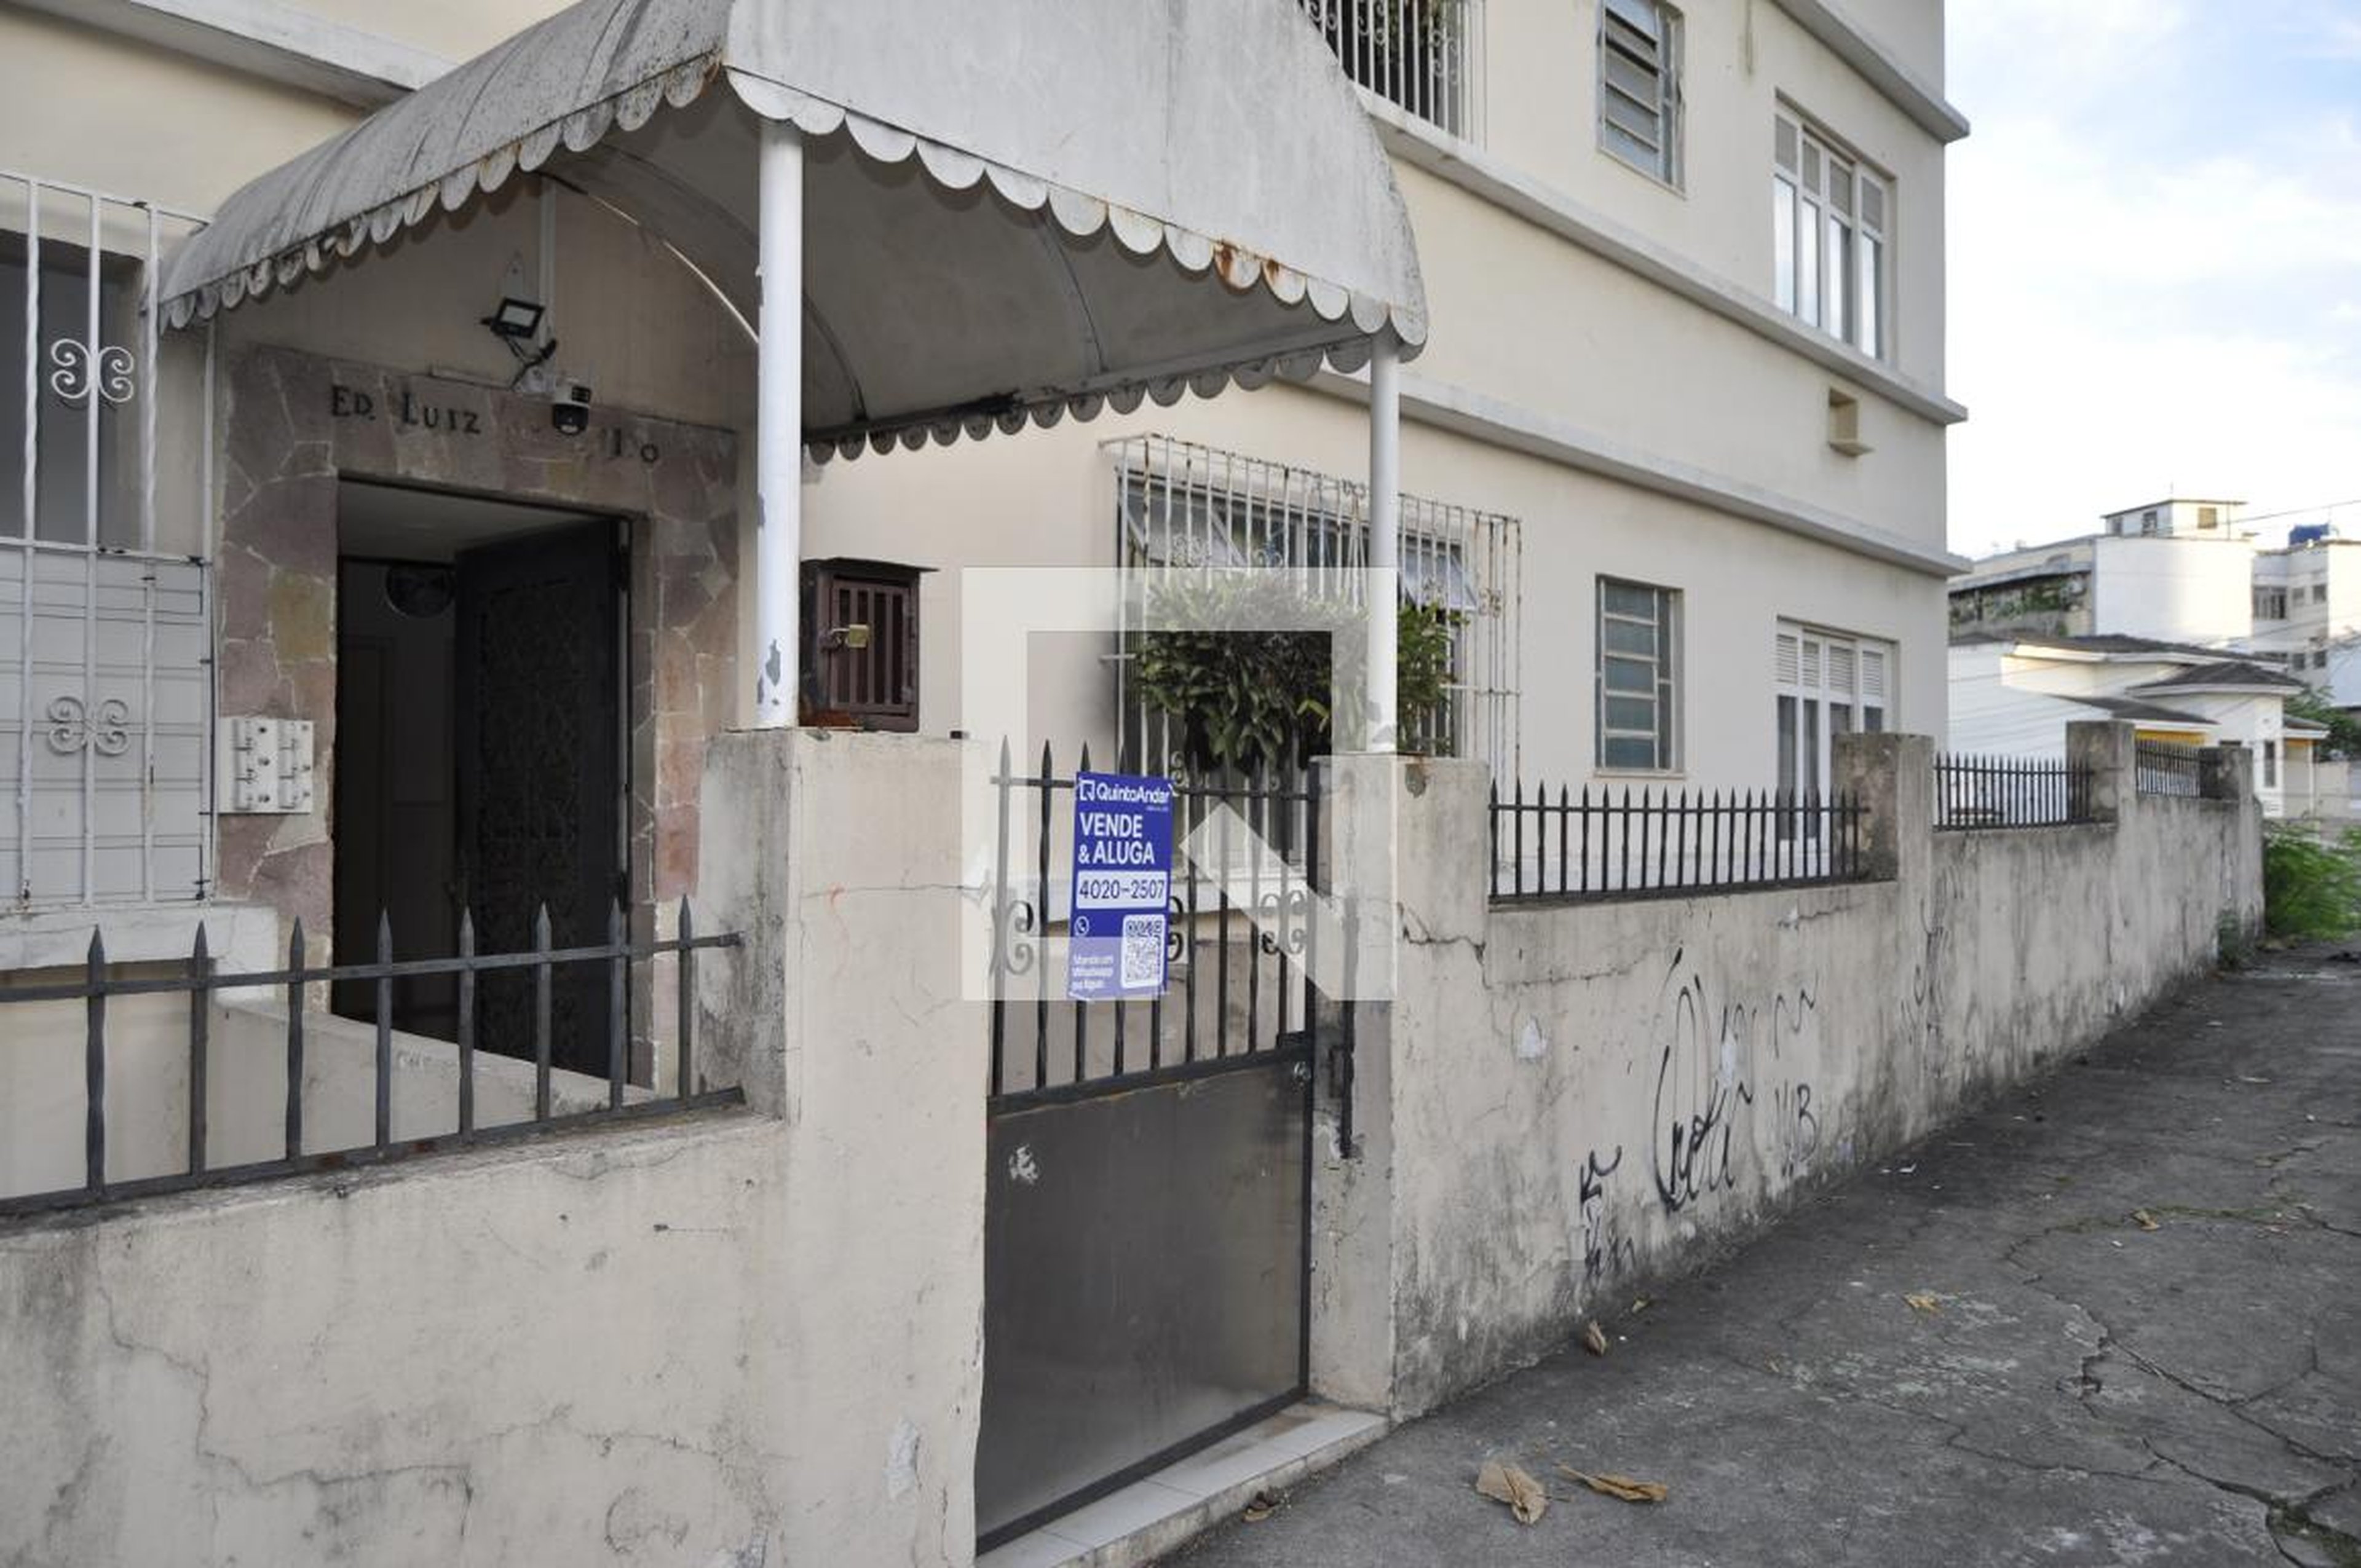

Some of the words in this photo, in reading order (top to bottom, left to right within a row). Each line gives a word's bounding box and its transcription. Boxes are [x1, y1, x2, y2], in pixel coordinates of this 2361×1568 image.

[1096, 781, 1169, 804] QuintoAndar
[1080, 812, 1143, 838] VENDE
[1078, 844, 1090, 864] &
[1093, 841, 1155, 865] ALUGA
[1080, 879, 1165, 900] 4020-2507
